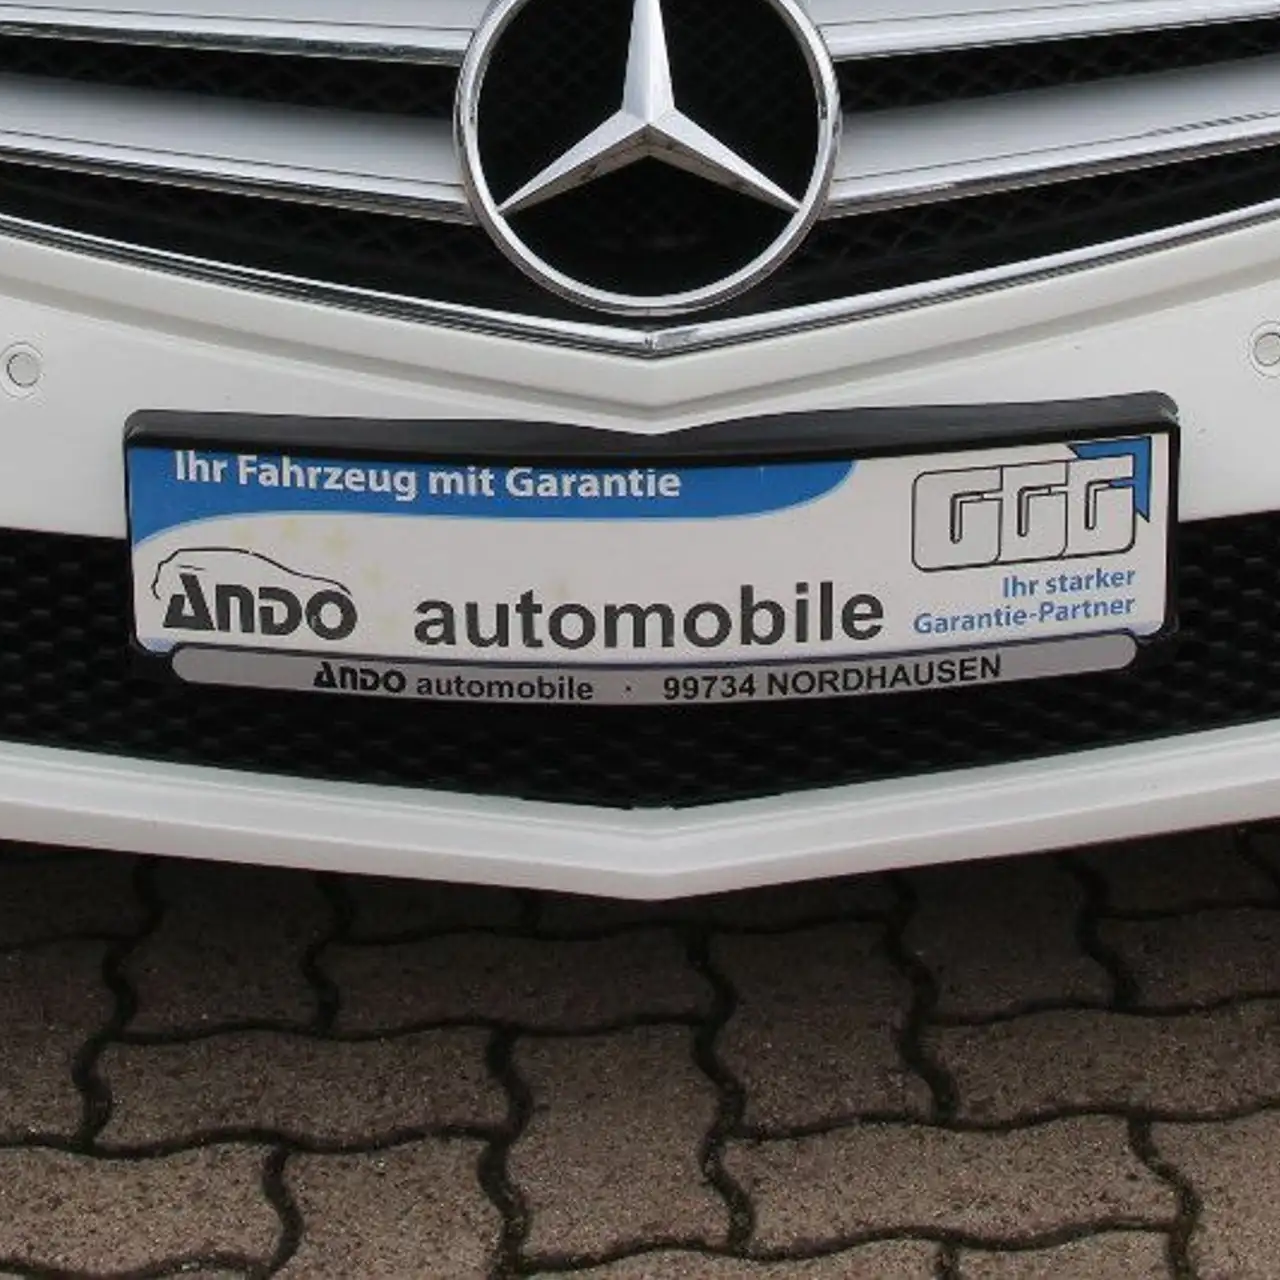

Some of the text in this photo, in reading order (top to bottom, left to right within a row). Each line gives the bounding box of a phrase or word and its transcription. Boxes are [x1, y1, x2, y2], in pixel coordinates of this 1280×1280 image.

[175, 449, 682, 502] Ihr Fahrzeug mit Garantie
[1002, 567, 1136, 598] Ihr starker
[413, 581, 885, 649] automobile
[913, 596, 1136, 634] Garantie-Partner
[416, 675, 594, 701] automobile
[663, 675, 757, 701] 99734
[767, 653, 1002, 697] NORDHAUSEN
